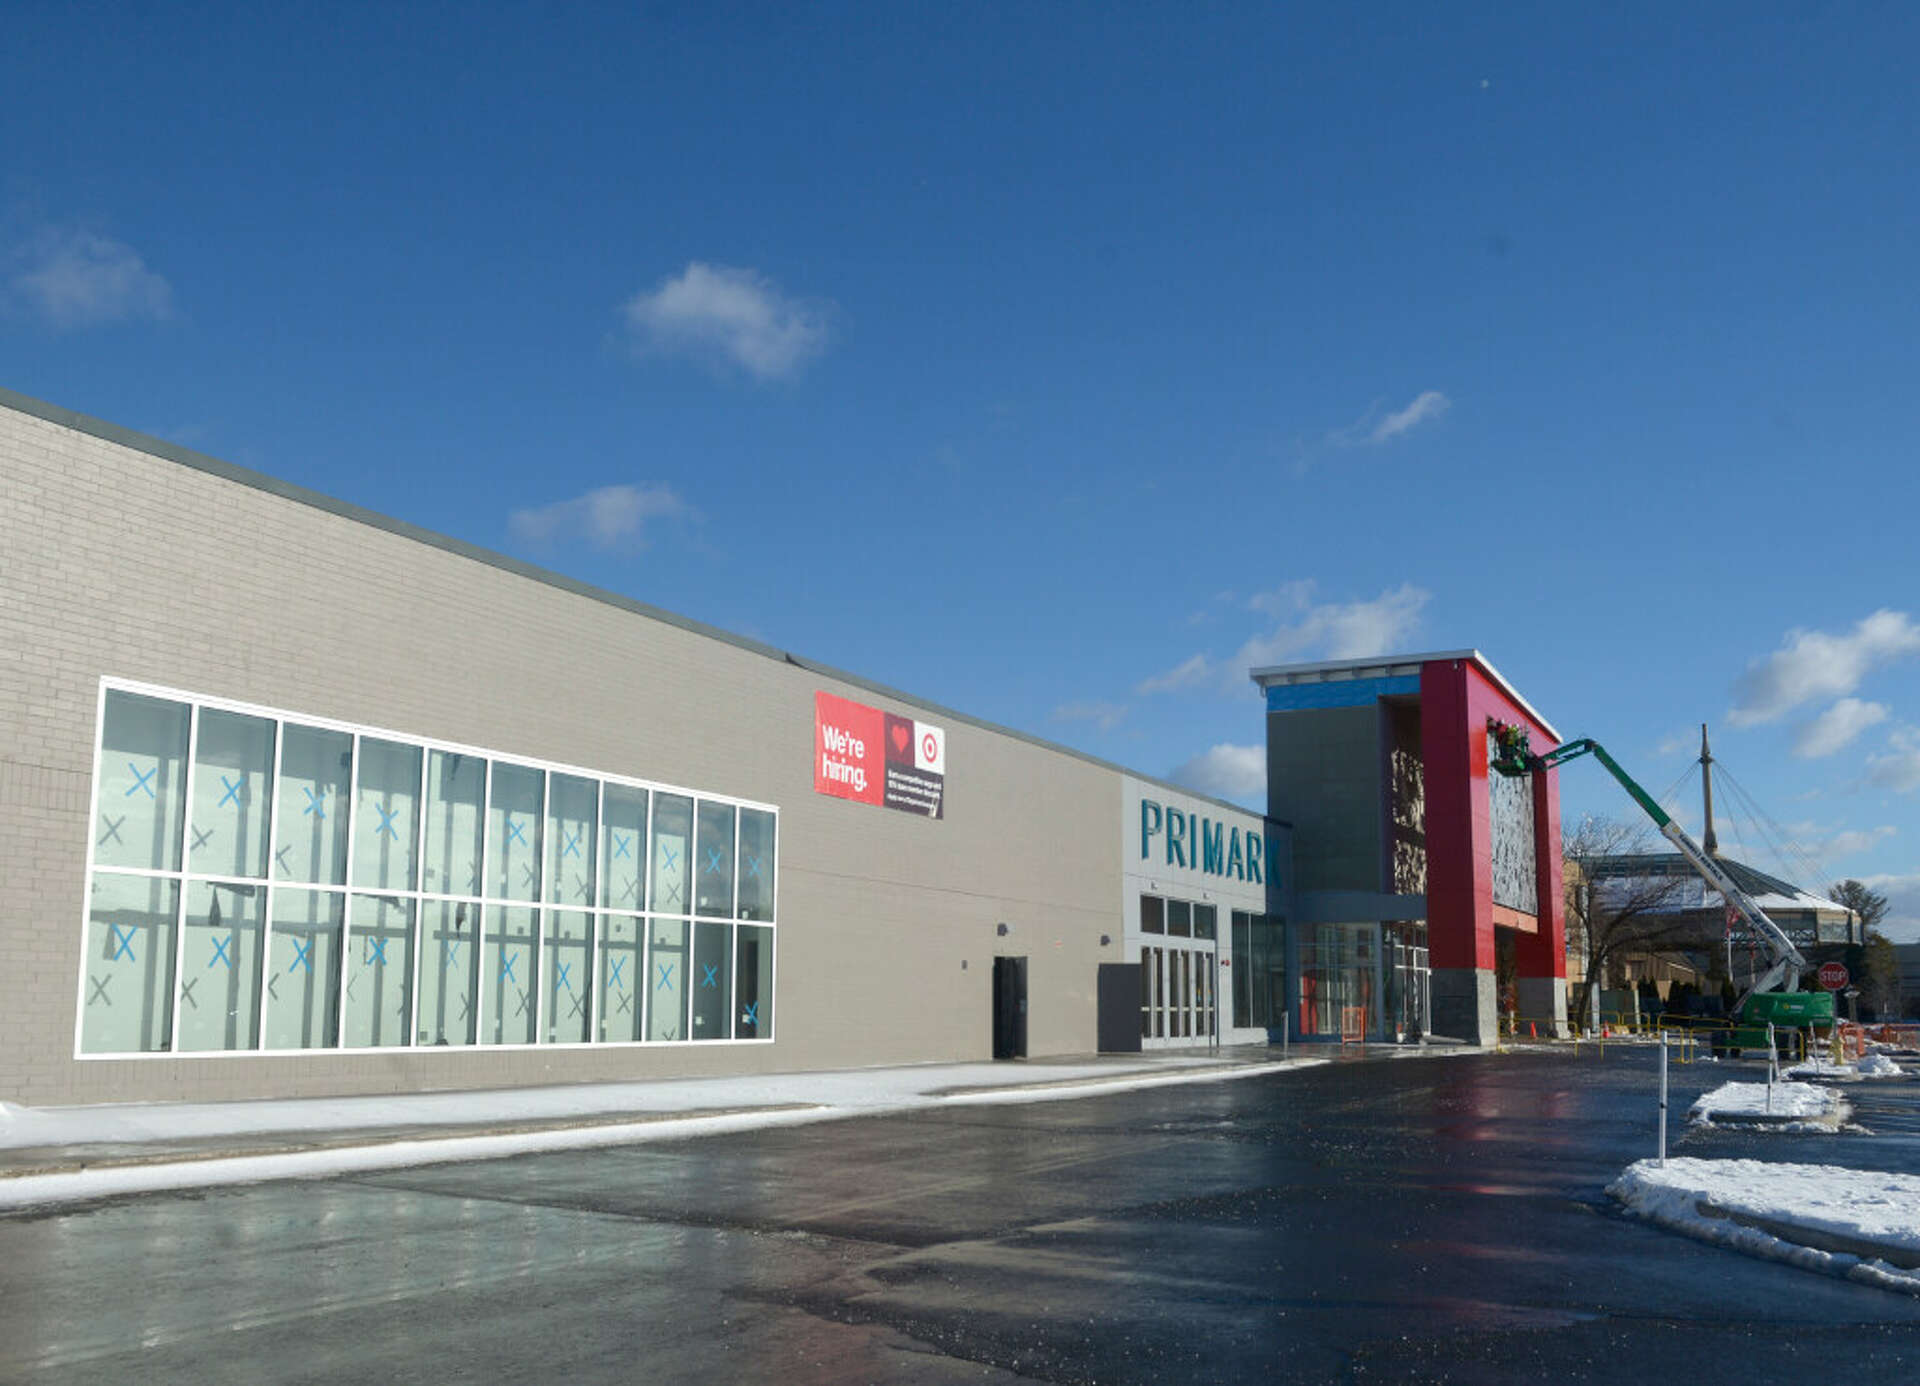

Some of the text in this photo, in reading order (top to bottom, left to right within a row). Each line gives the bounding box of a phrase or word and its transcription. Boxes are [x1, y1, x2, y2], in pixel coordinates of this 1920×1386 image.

[822, 725, 864, 758] We're
[822, 754, 868, 792] hiring.
[1141, 798, 1282, 889] PRIMARK
[1820, 970, 1846, 983] STOP
